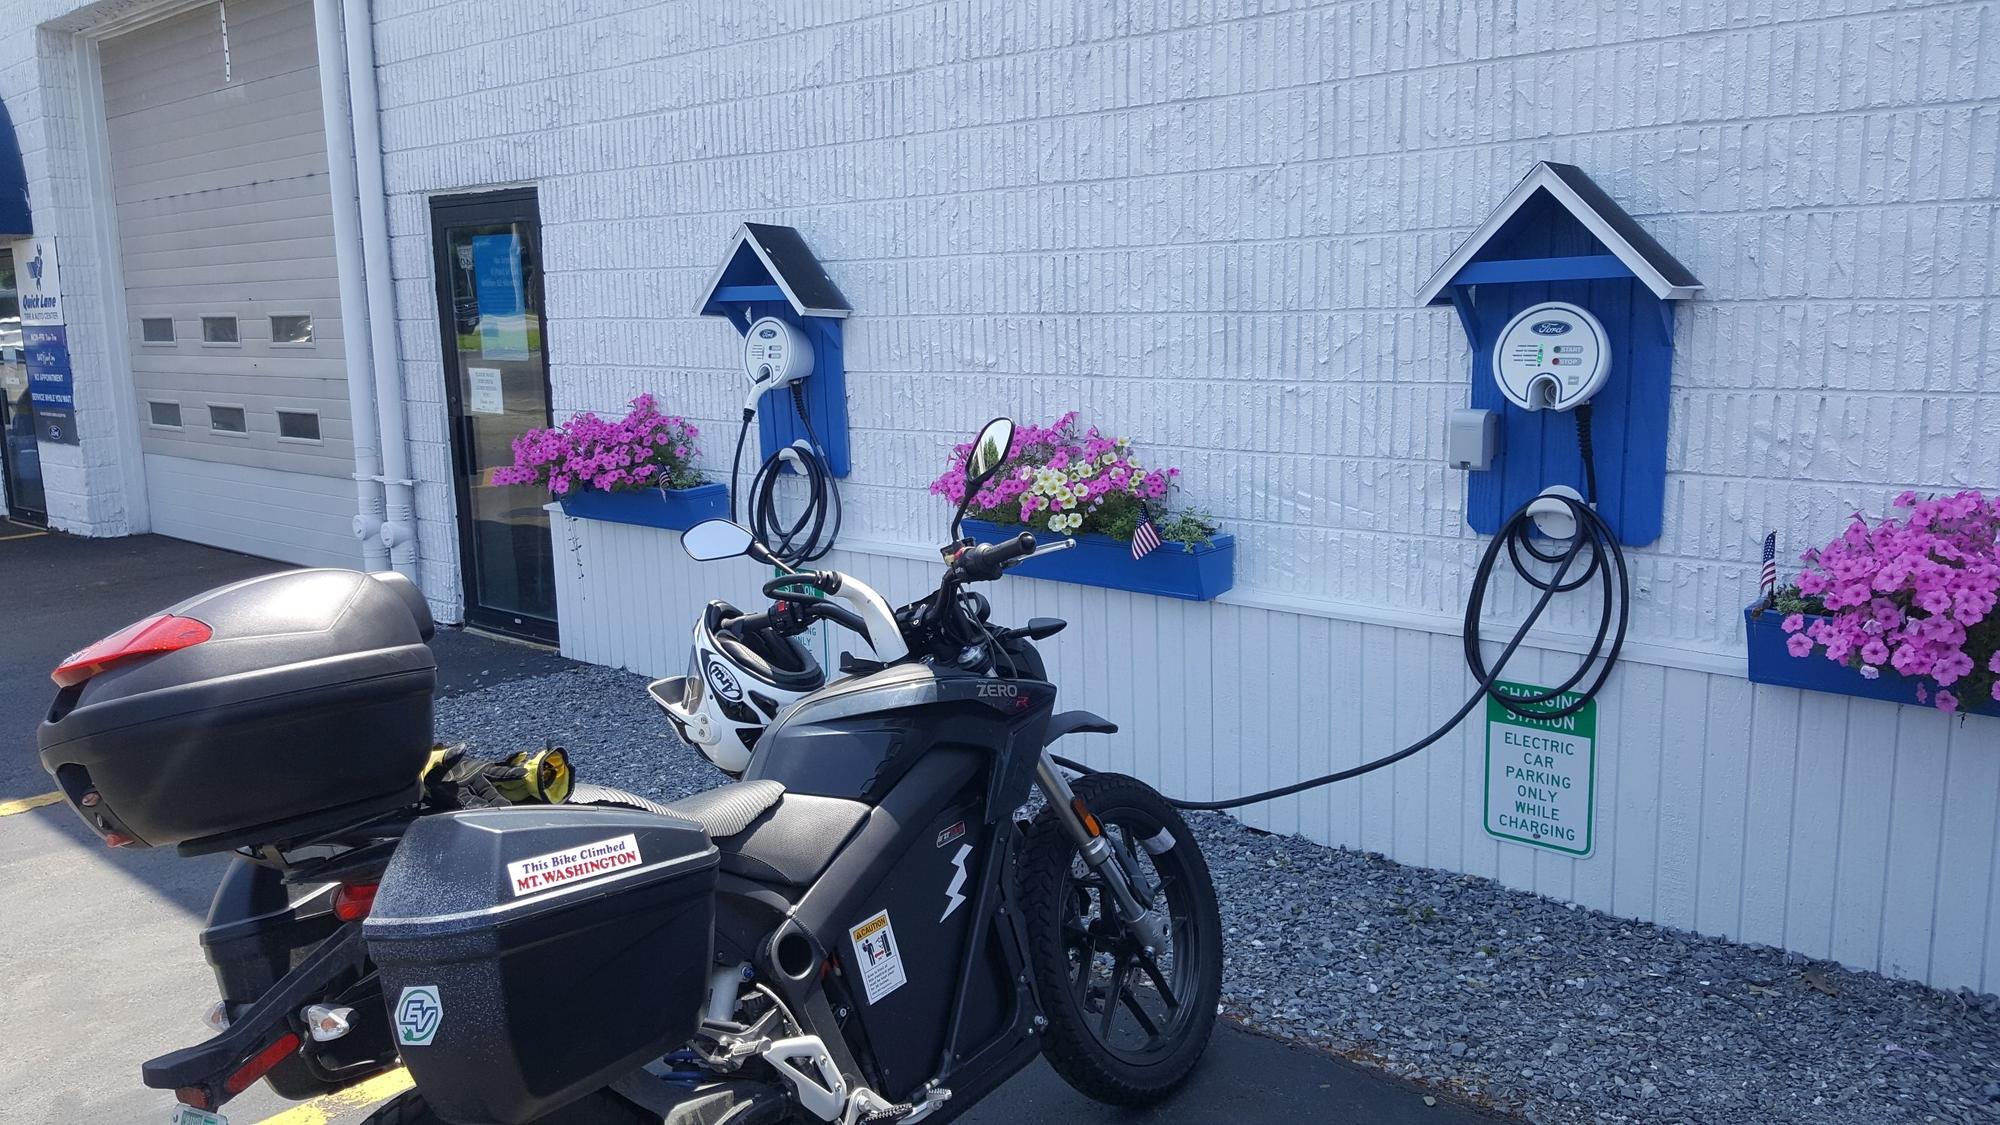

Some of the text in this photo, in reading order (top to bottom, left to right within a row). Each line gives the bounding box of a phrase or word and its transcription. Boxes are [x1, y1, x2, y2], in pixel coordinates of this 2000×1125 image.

[23, 294, 57, 311] Quick Lane
[1538, 323, 1566, 334] Ford
[711, 666, 740, 692] Arai
[976, 684, 1018, 697] ZERO
[1504, 732, 1575, 756] ELECTRIC
[1523, 753, 1554, 769] CAR
[1506, 766, 1571, 789] PARKING
[1517, 785, 1558, 803] ONLY
[1515, 801, 1560, 821] WHILE
[1499, 814, 1575, 841] CHARGING
[522, 841, 625, 874] This Bike Climbed
[861, 916, 886, 935] CAUTION
[403, 1000, 439, 1033] EV
